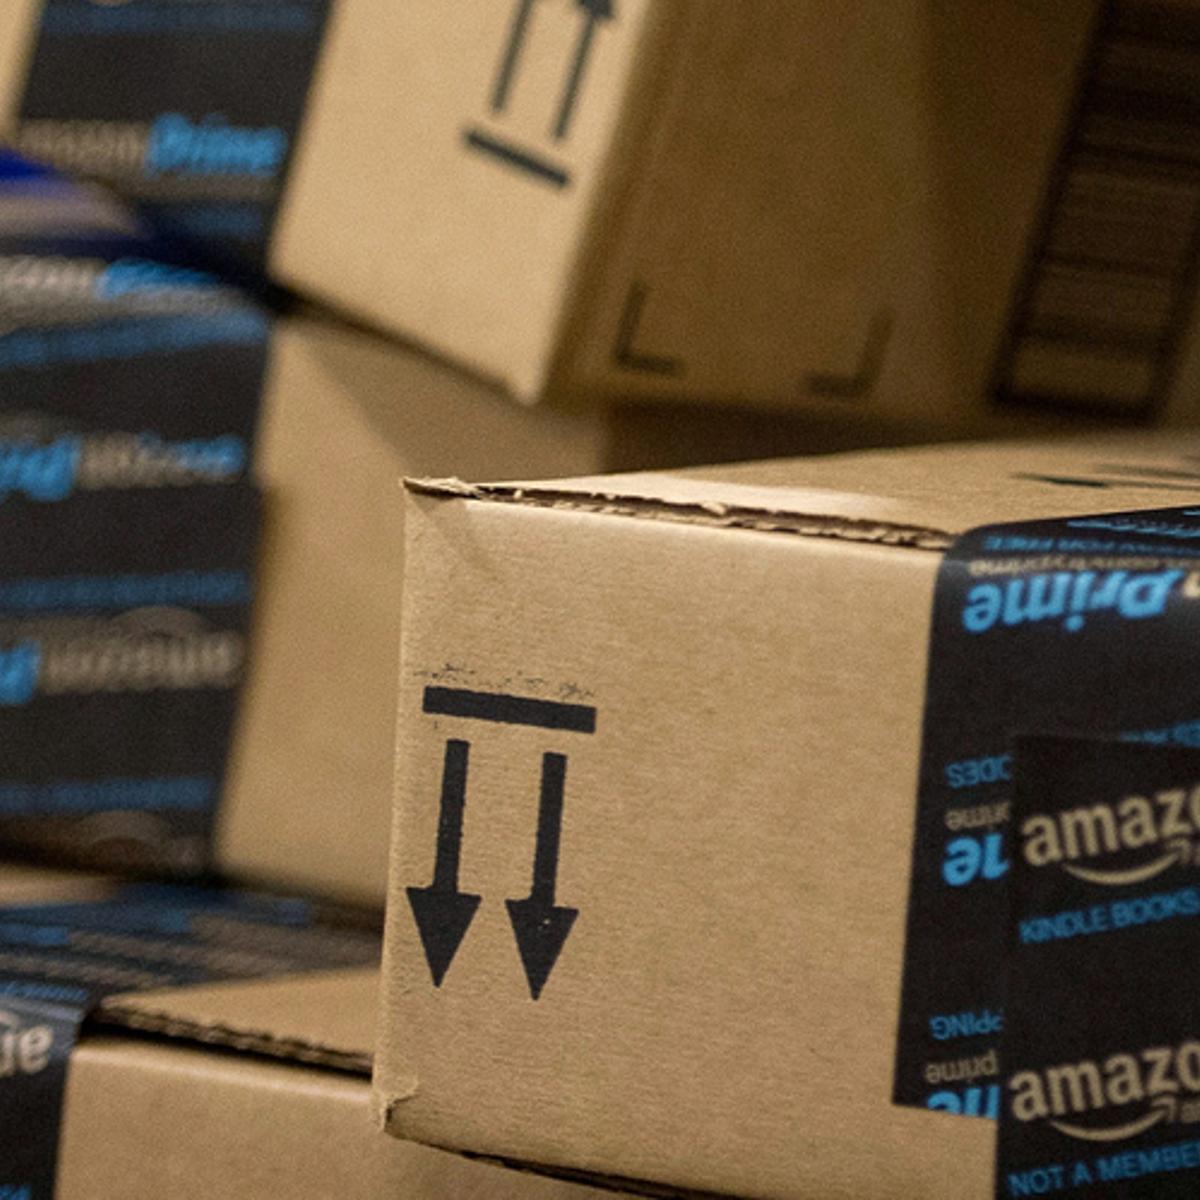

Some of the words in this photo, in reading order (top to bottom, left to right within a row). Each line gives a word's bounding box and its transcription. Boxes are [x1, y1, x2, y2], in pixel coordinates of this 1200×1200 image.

[1018, 908, 1111, 944] KINDLE
[1112, 888, 1200, 927] BOOKS
[1007, 1167, 1068, 1199] NOT
[1072, 1160, 1093, 1186] A
